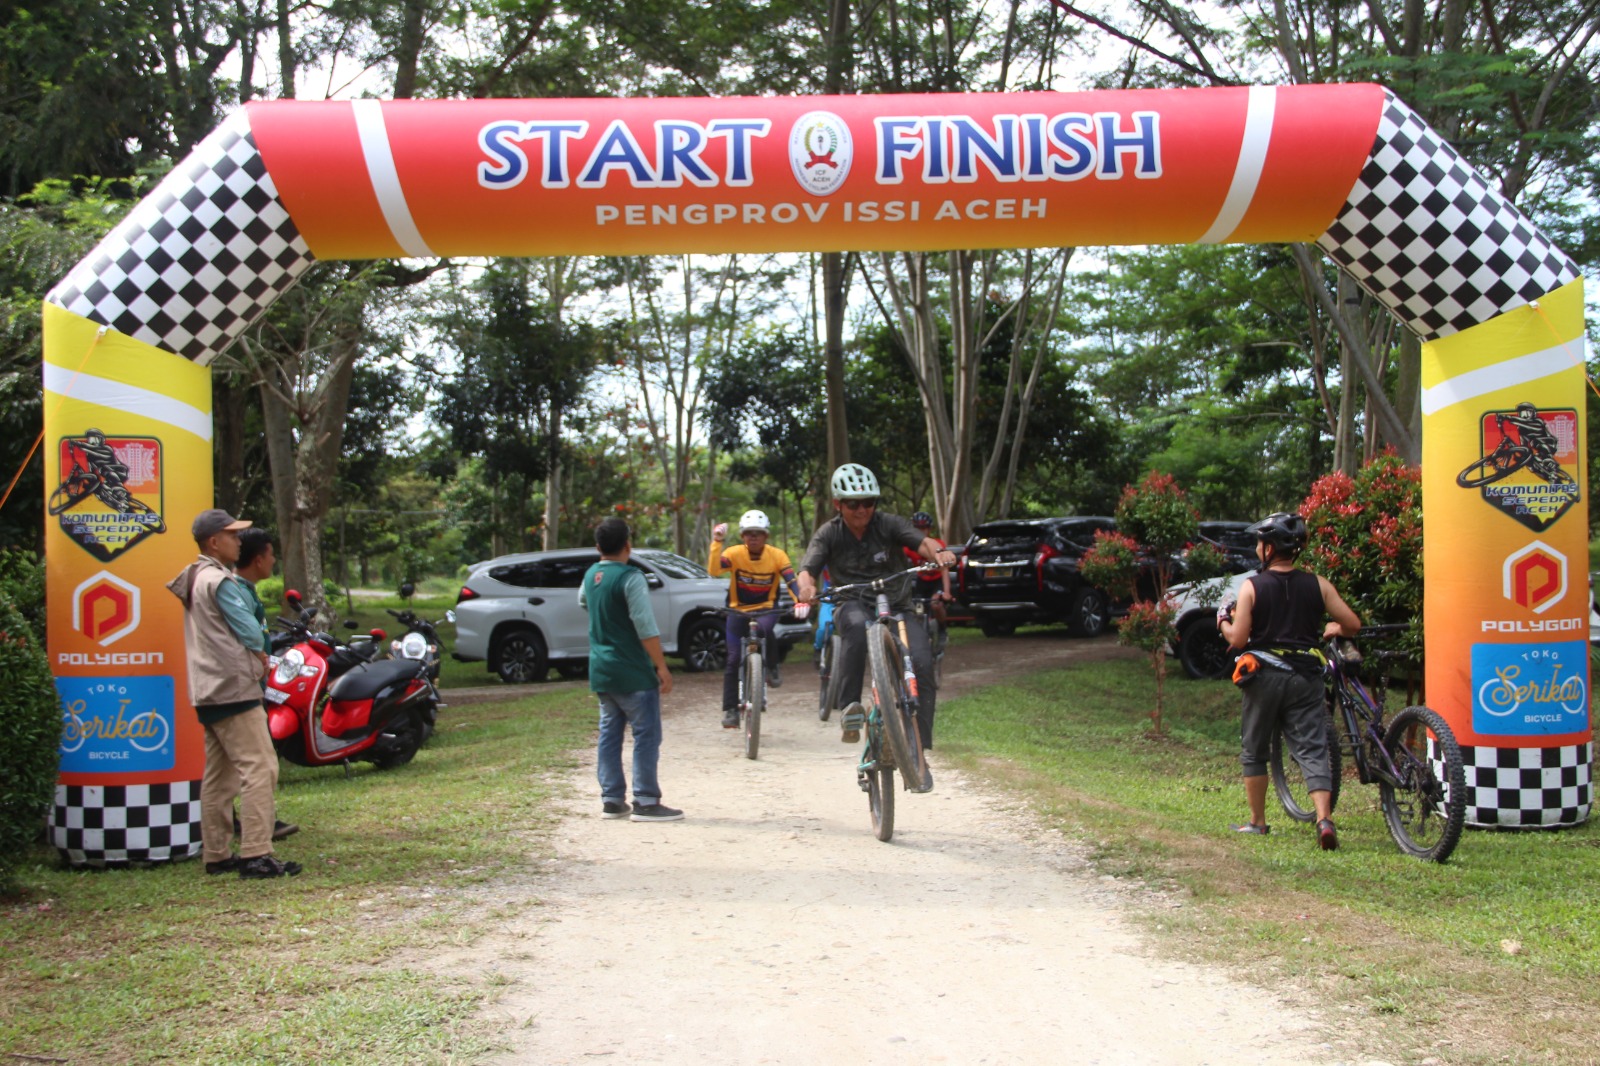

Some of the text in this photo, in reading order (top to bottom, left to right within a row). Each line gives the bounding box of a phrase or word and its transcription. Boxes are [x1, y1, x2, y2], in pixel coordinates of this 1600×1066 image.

[478, 119, 771, 190] START
[873, 111, 1163, 185] FINISH
[596, 198, 1047, 226] PENGPROV ISSI ACEH
[1486, 483, 1578, 497] KOMUNITAS
[1502, 496, 1568, 506] SEPEDA
[1516, 505, 1558, 515] ACEH
[61, 512, 160, 525] KOMUNITAS
[73, 525, 144, 534] SEPEDA
[84, 535, 130, 544] ACEH
[1481, 618, 1582, 632] POLYGON
[58, 652, 164, 665] POLYGON
[1521, 649, 1559, 661] TOKO
[87, 684, 127, 695] TOKO
[1491, 664, 1580, 705] Serikat
[64, 699, 159, 741] Serikat
[1524, 714, 1562, 723] BICYCLE
[88, 751, 130, 760] BICYCLE
